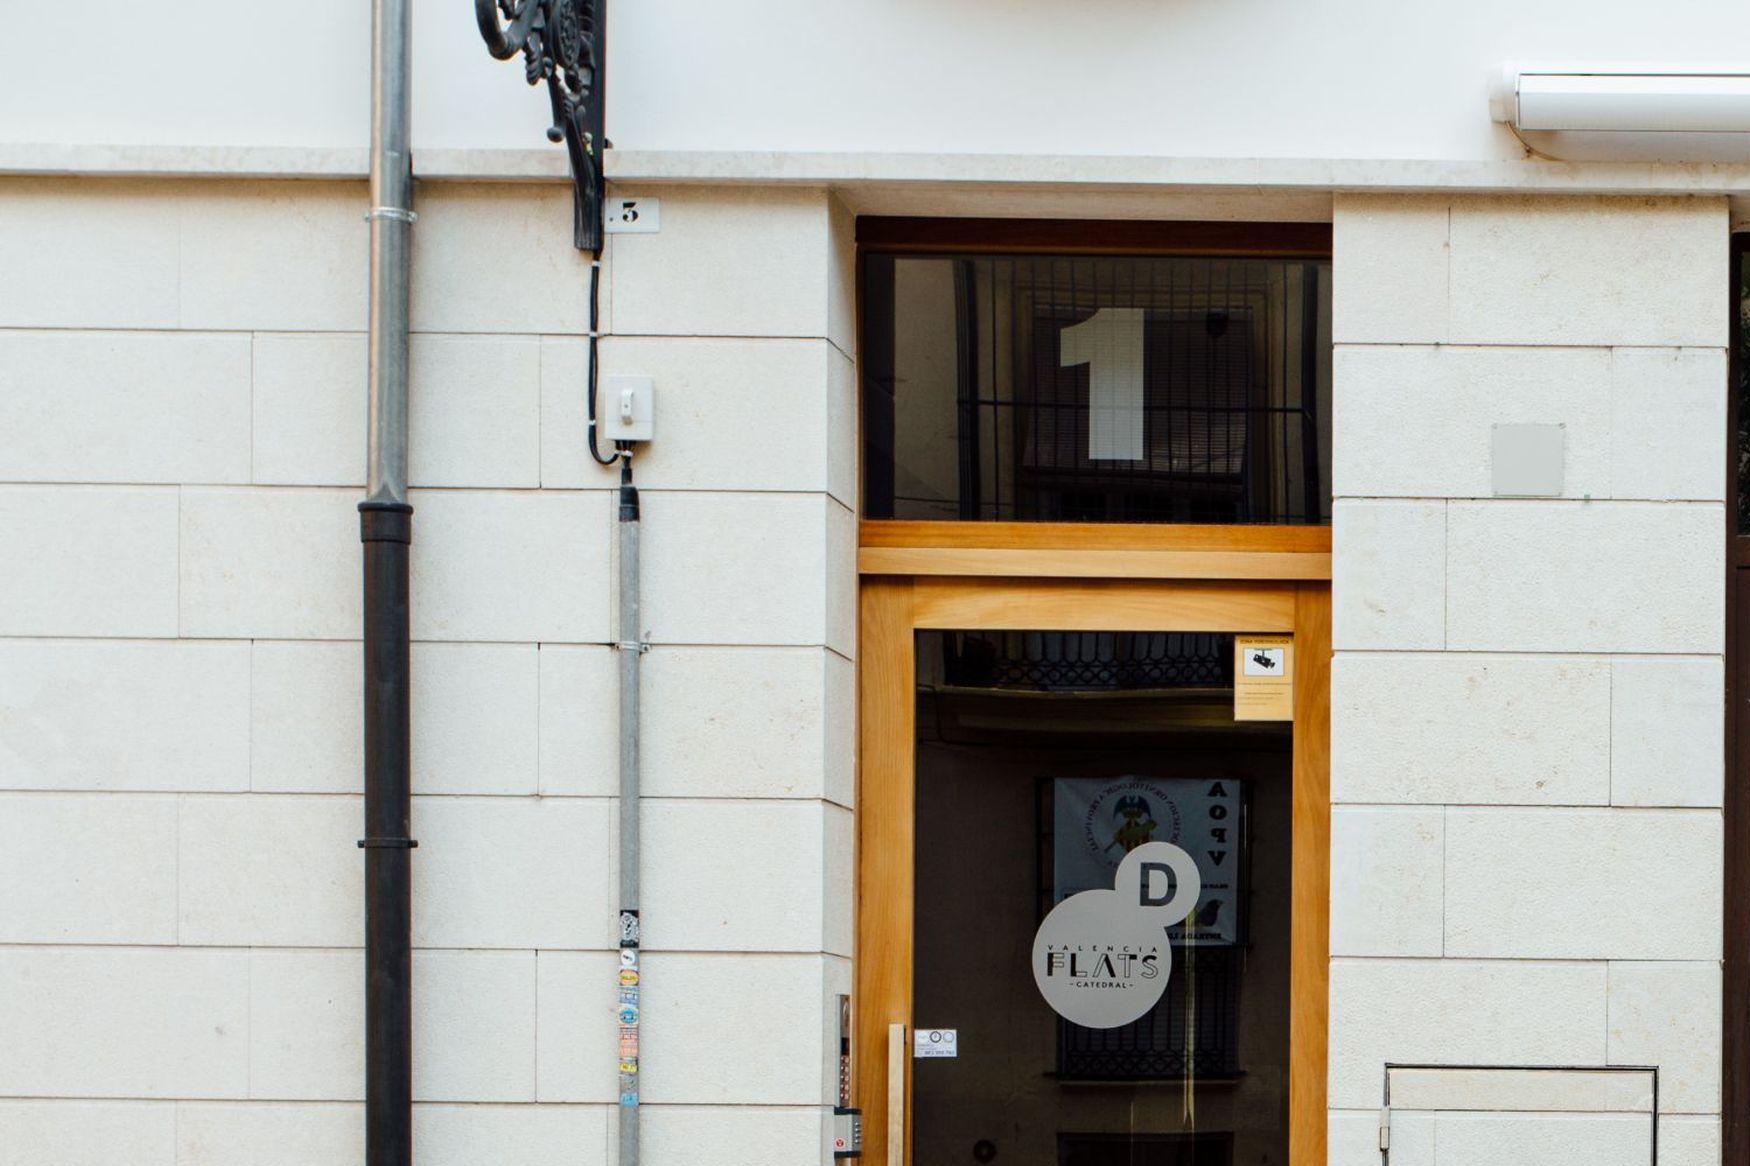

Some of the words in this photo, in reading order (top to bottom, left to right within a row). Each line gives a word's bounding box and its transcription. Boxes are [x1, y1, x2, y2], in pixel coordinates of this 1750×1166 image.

[1060, 308, 1144, 460] 1
[1139, 862, 1178, 907] D
[1047, 944, 1158, 953] VALENCIA
[1047, 952, 1159, 979] FLATS
